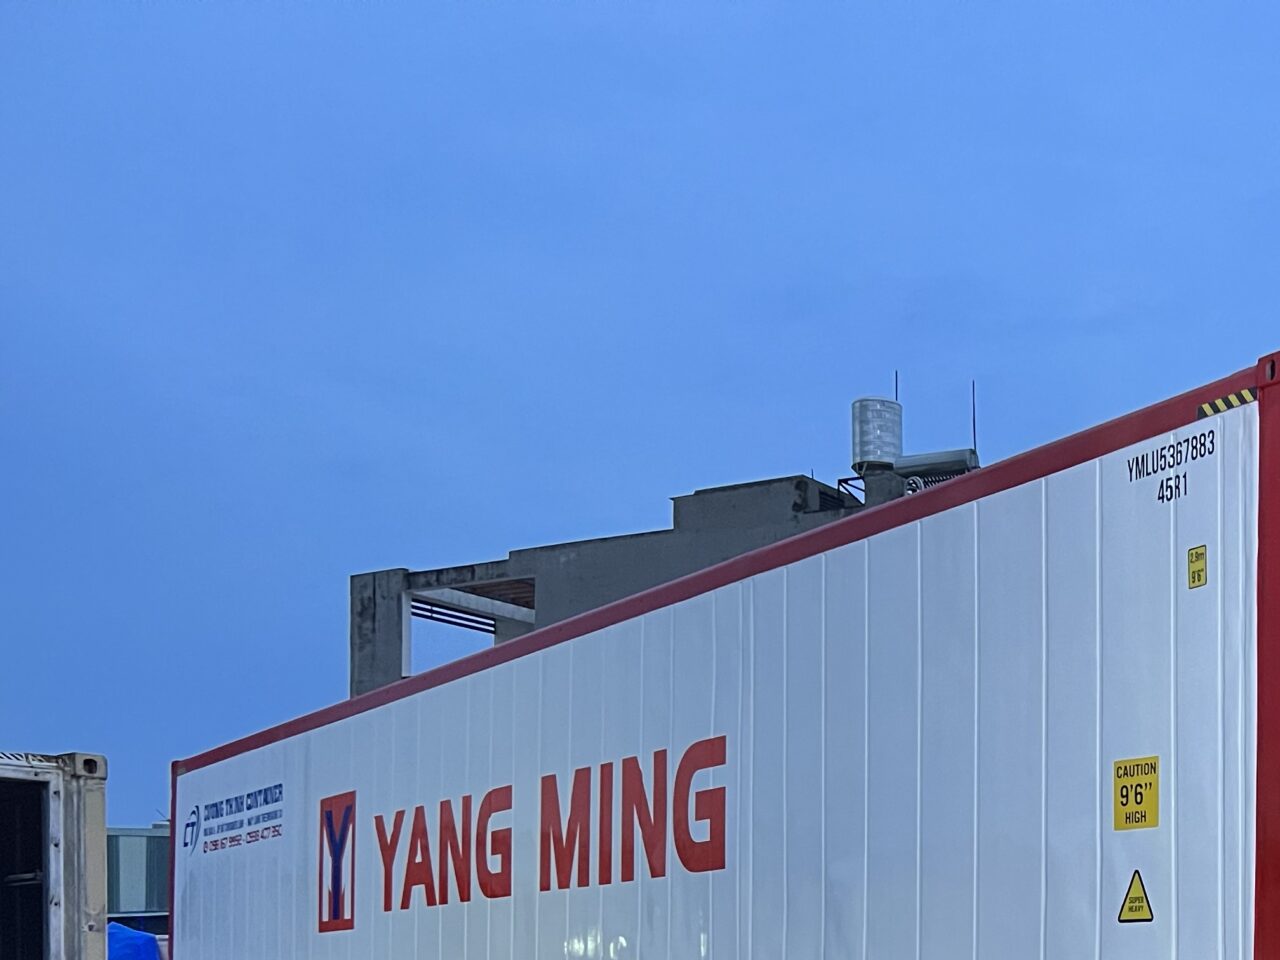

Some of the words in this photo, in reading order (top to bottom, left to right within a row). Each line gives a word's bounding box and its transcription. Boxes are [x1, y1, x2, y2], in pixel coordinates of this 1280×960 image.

[1127, 429, 1215, 482] YMLU5367883
[1157, 471, 1187, 504] 45R1
[1116, 761, 1157, 779] CAUTION
[374, 784, 513, 912] YANG
[540, 735, 726, 892] MING
[1125, 810, 1147, 824] HIGH
